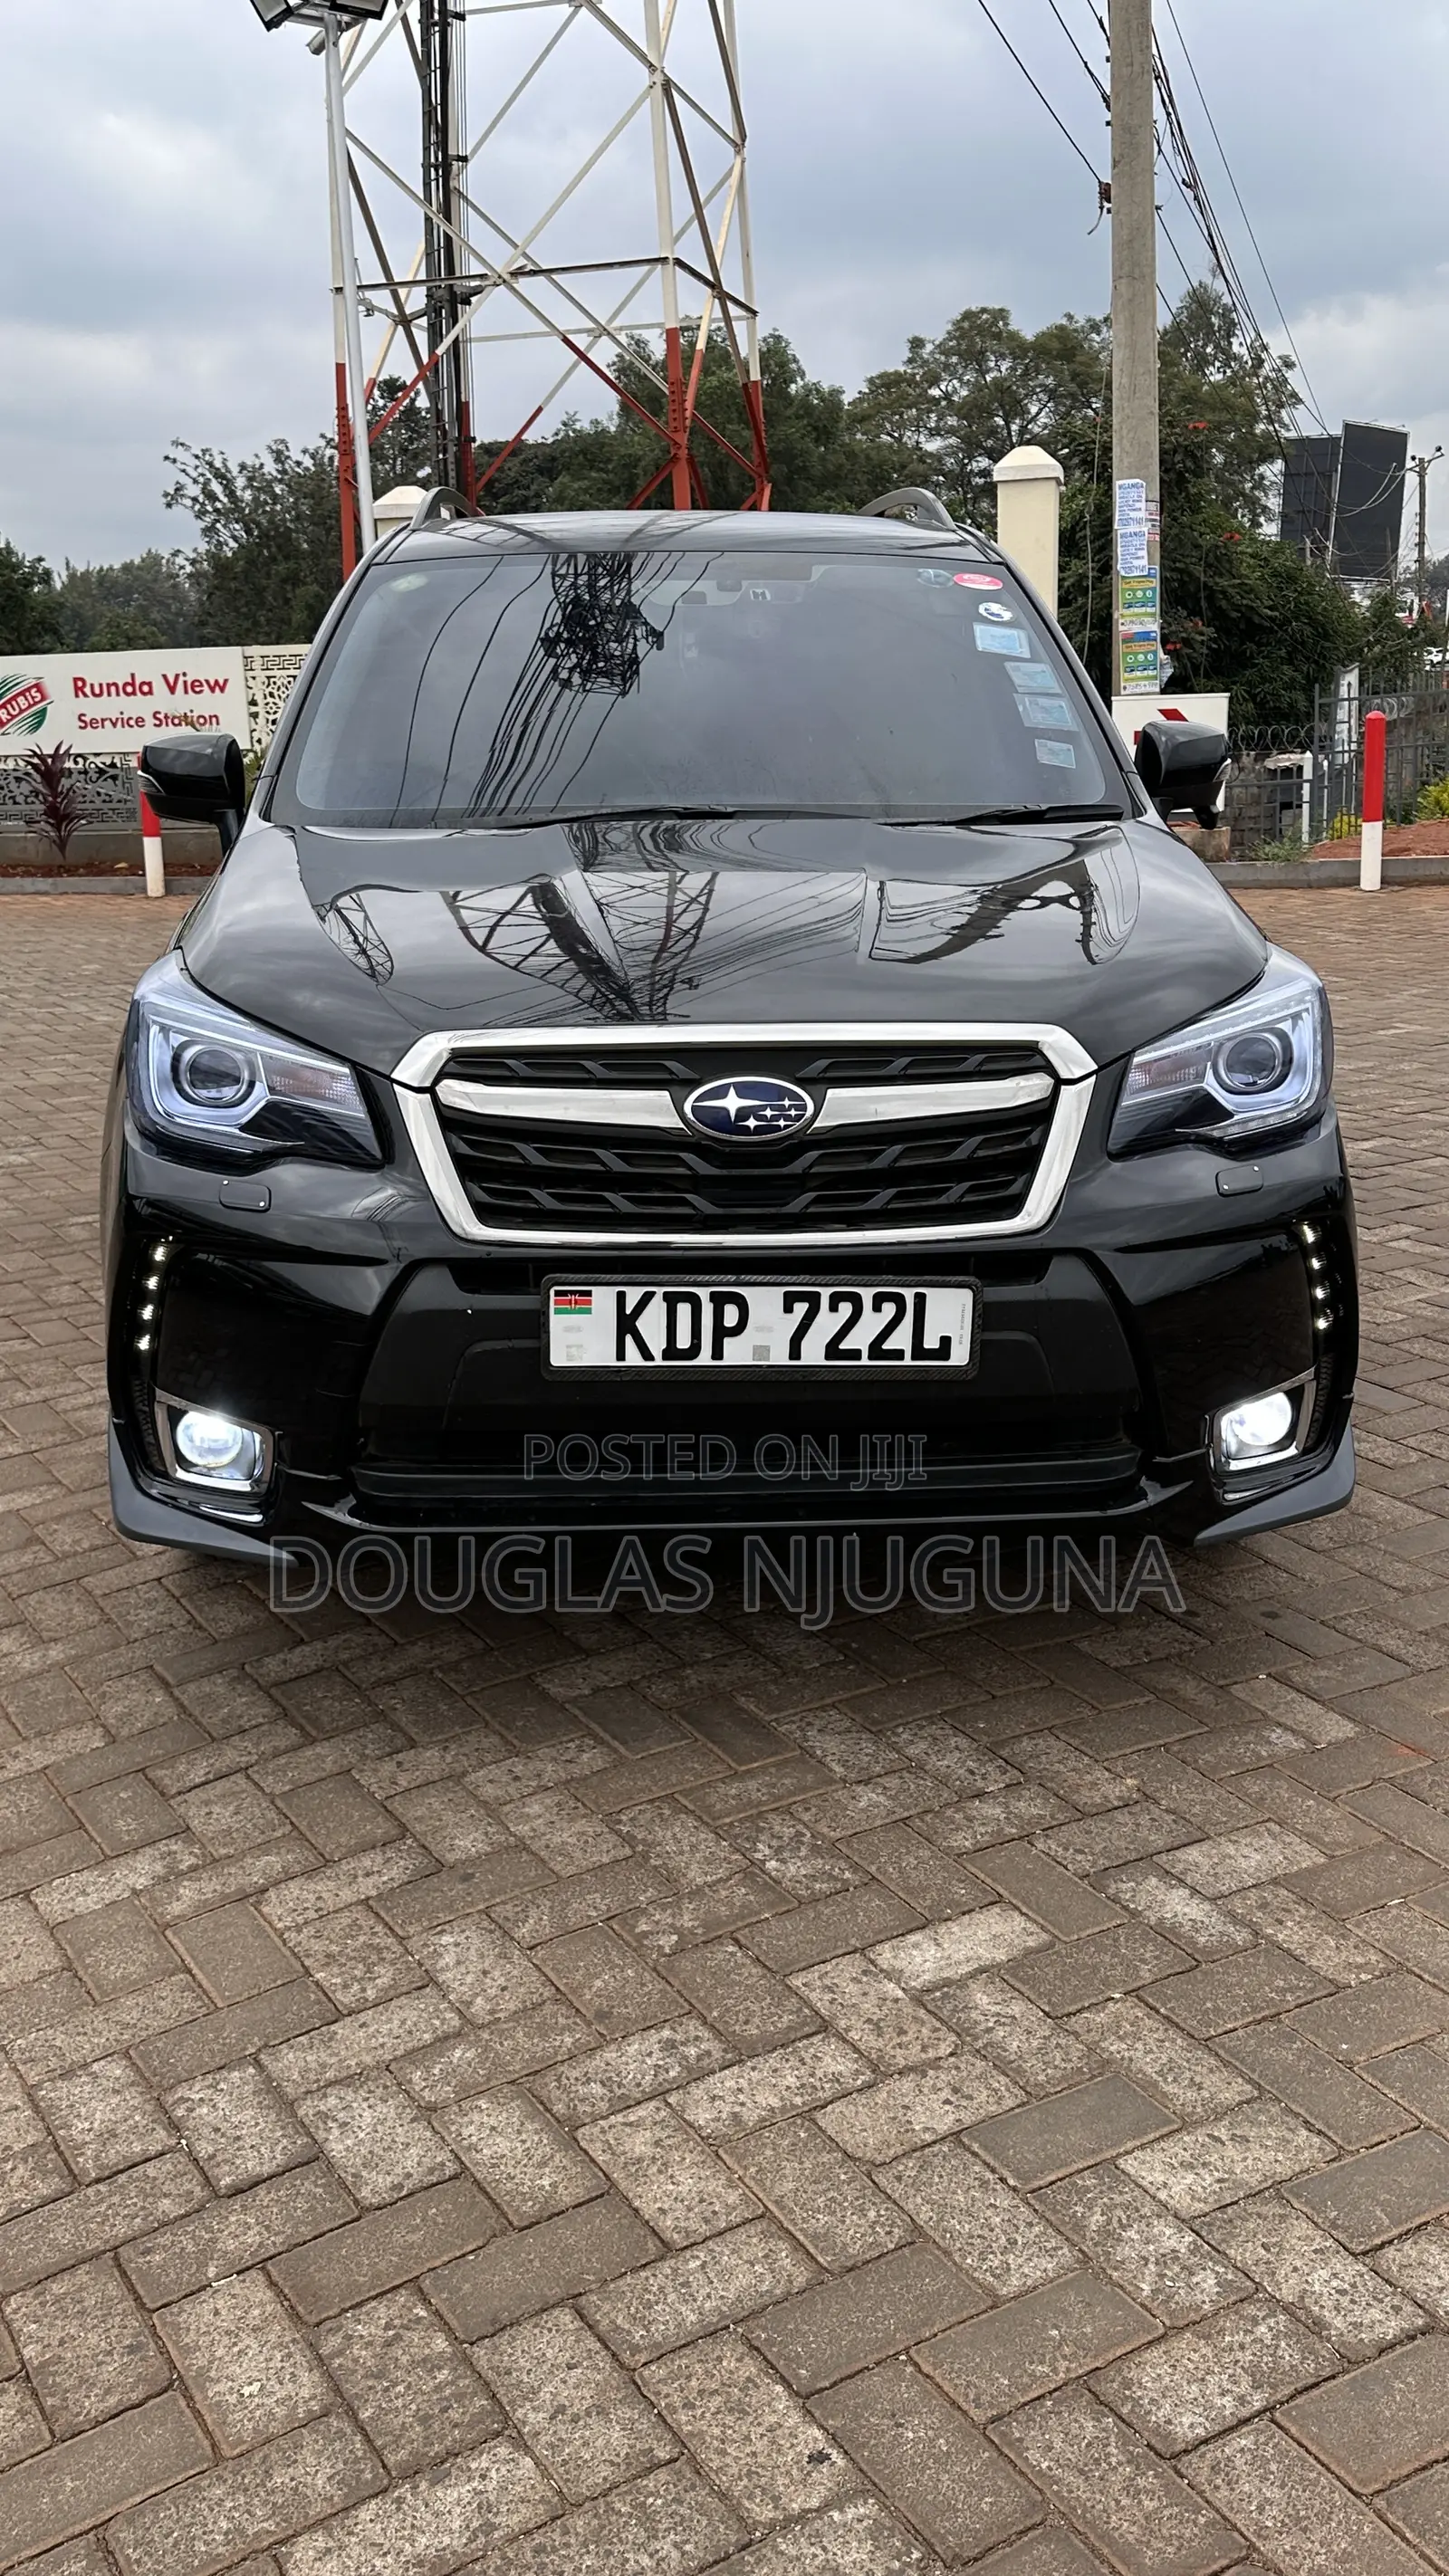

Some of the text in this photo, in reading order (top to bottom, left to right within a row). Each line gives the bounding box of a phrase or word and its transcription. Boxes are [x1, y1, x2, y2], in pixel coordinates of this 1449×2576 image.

[72, 671, 229, 699] Runda View
[77, 709, 220, 730] Service Station
[615, 1289, 750, 1362] KDP
[782, 1289, 953, 1362] 722L
